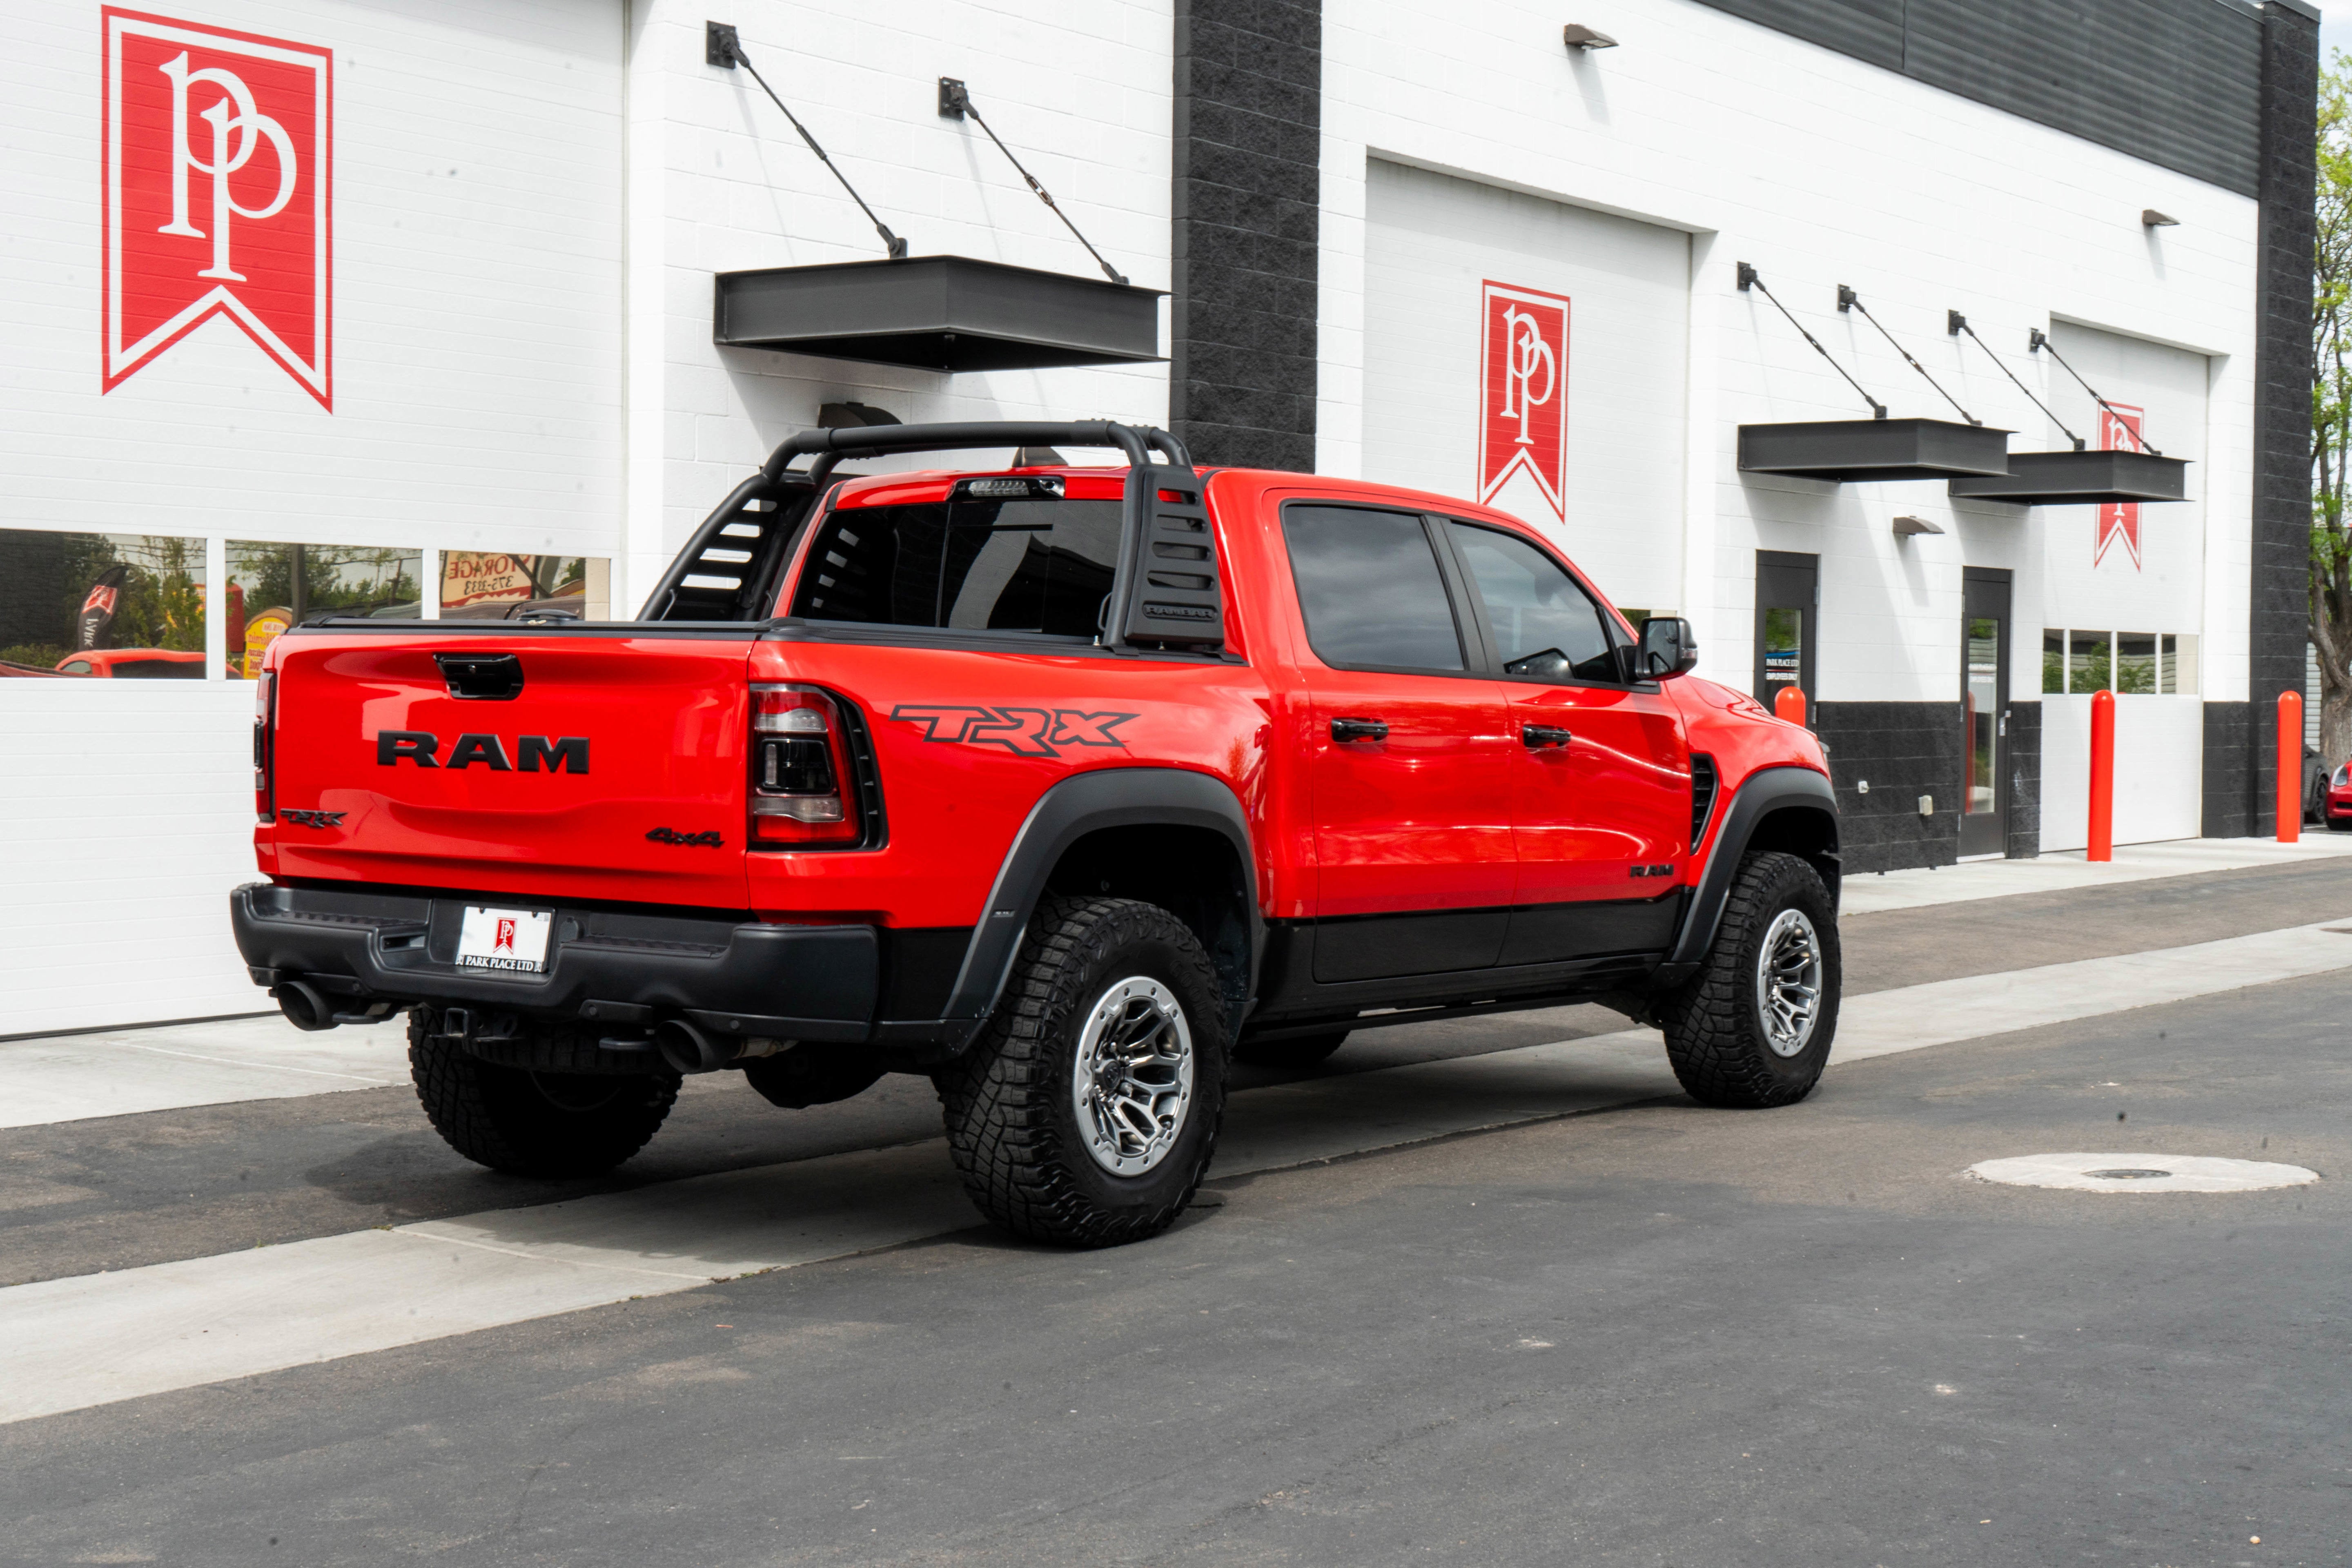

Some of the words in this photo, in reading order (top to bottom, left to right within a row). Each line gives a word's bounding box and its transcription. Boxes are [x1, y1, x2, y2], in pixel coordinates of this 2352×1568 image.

[1145, 606, 1214, 618] RAMBAR
[889, 704, 1142, 757] TRX
[377, 730, 590, 774] RAM
[280, 808, 348, 828] TRX
[646, 827, 724, 849] 4x4
[1630, 864, 1674, 877] RAM
[465, 956, 490, 967] PARK
[490, 958, 516, 969] PLACE
[516, 960, 534, 971] LTD
